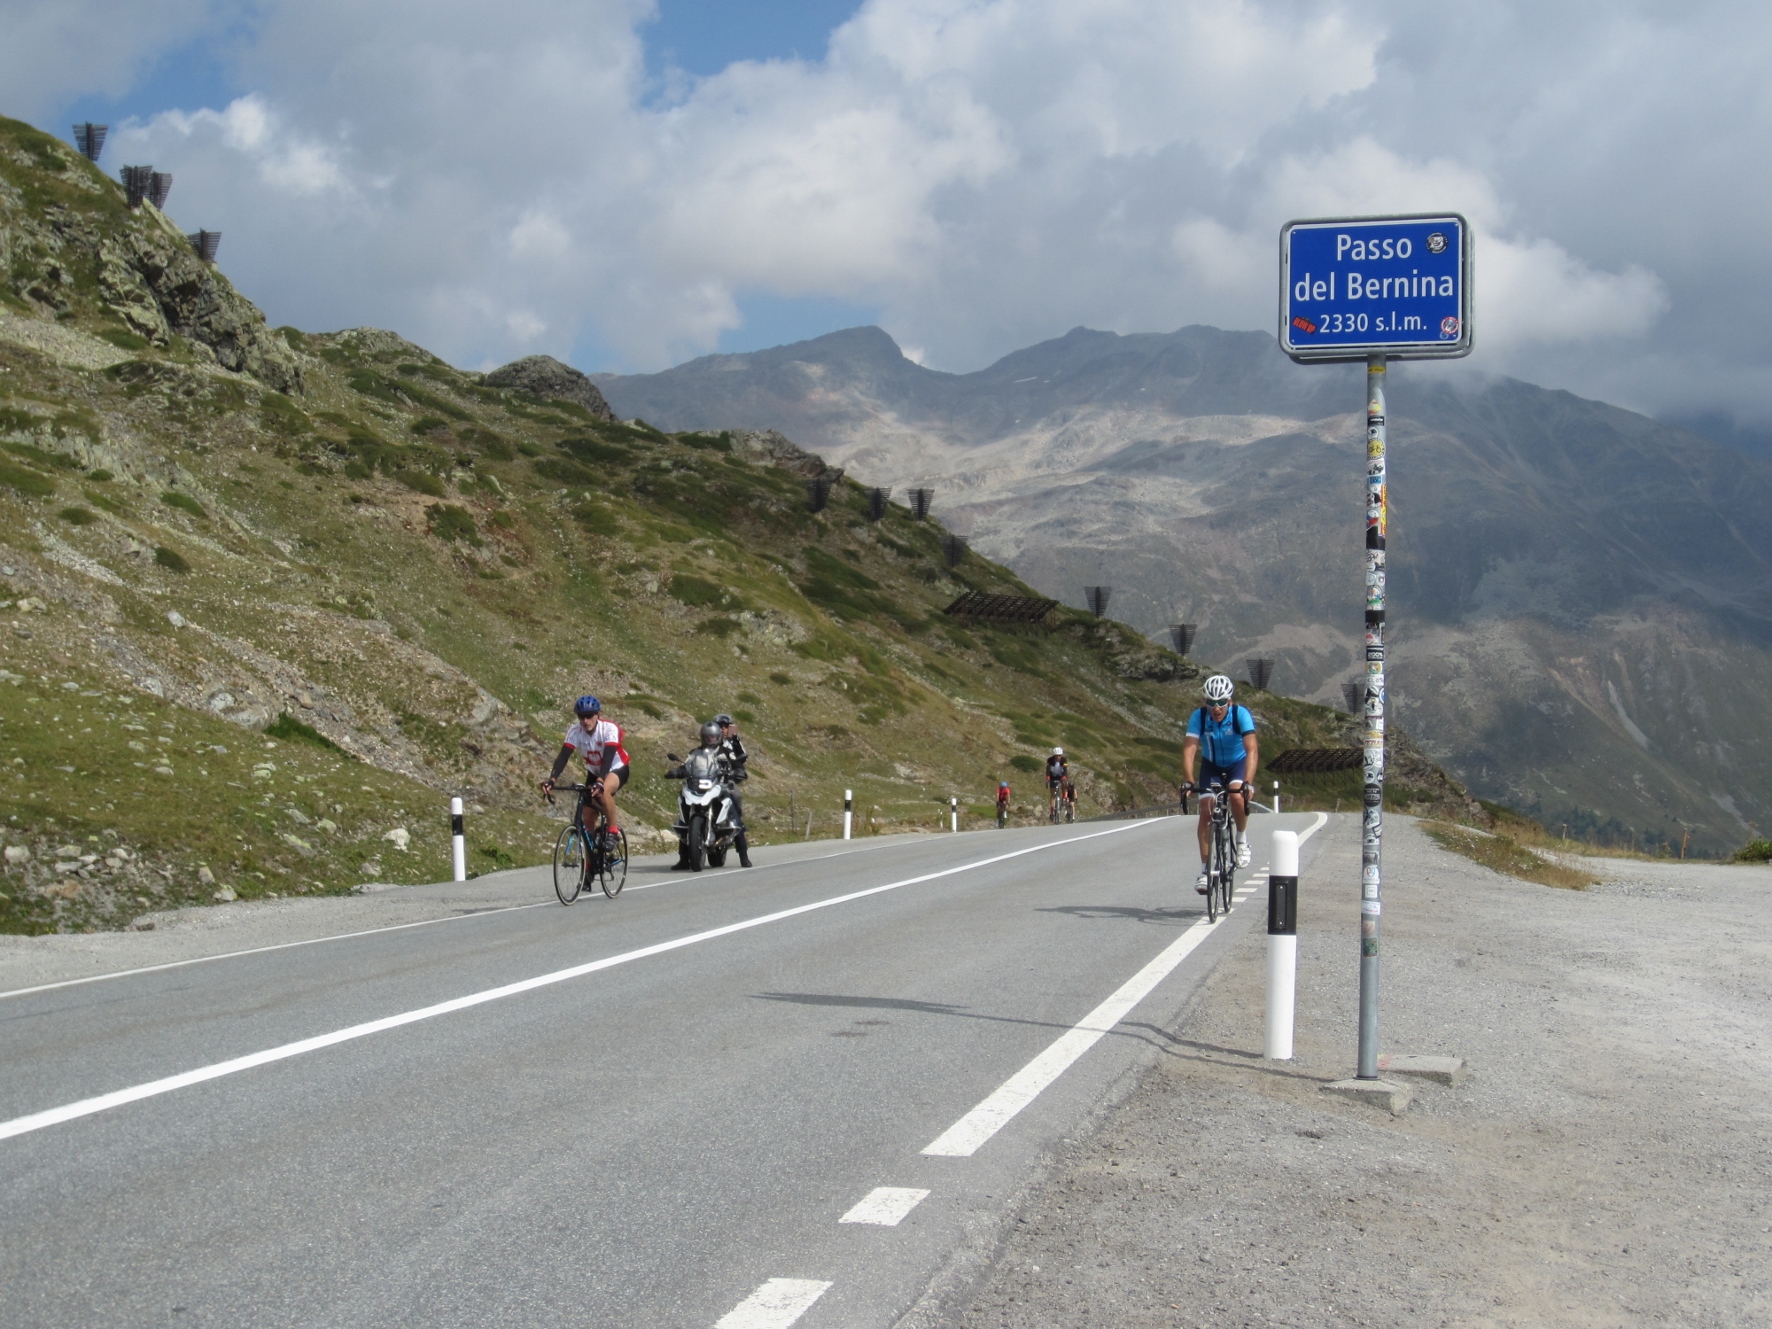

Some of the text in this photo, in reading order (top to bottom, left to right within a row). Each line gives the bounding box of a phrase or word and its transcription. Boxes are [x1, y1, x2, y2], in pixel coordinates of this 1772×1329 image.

[1337, 234, 1413, 261] Passo
[1294, 269, 1454, 301] del Bernina
[1319, 313, 1369, 333] 2330
[1375, 310, 1427, 331] s.l.m.
